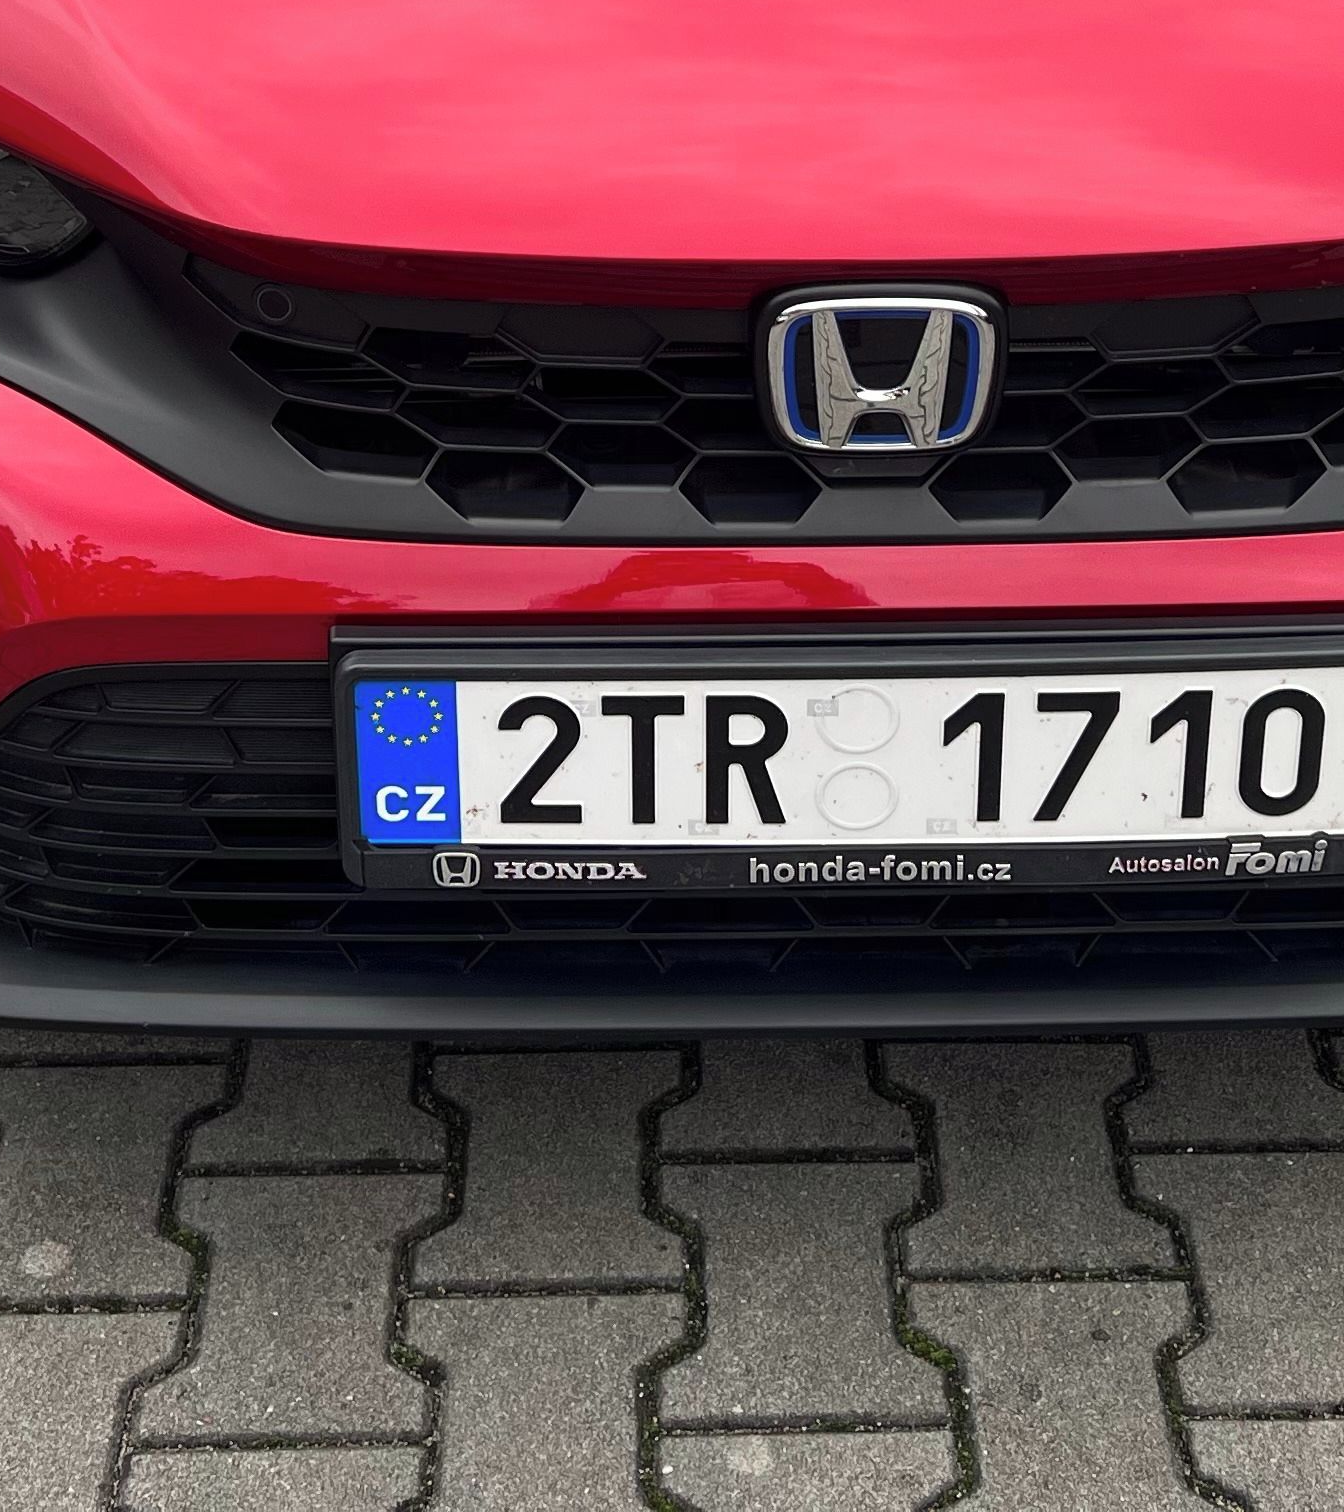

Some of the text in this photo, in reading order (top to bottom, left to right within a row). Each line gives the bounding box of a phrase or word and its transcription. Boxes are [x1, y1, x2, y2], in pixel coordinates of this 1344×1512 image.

[497, 687, 1326, 825] 2TR 1710
[374, 785, 447, 822] CZ
[493, 861, 647, 880] HONDA
[749, 854, 1012, 884] honda-fomi.cz
[1108, 839, 1329, 876] Autosalon Fomi
